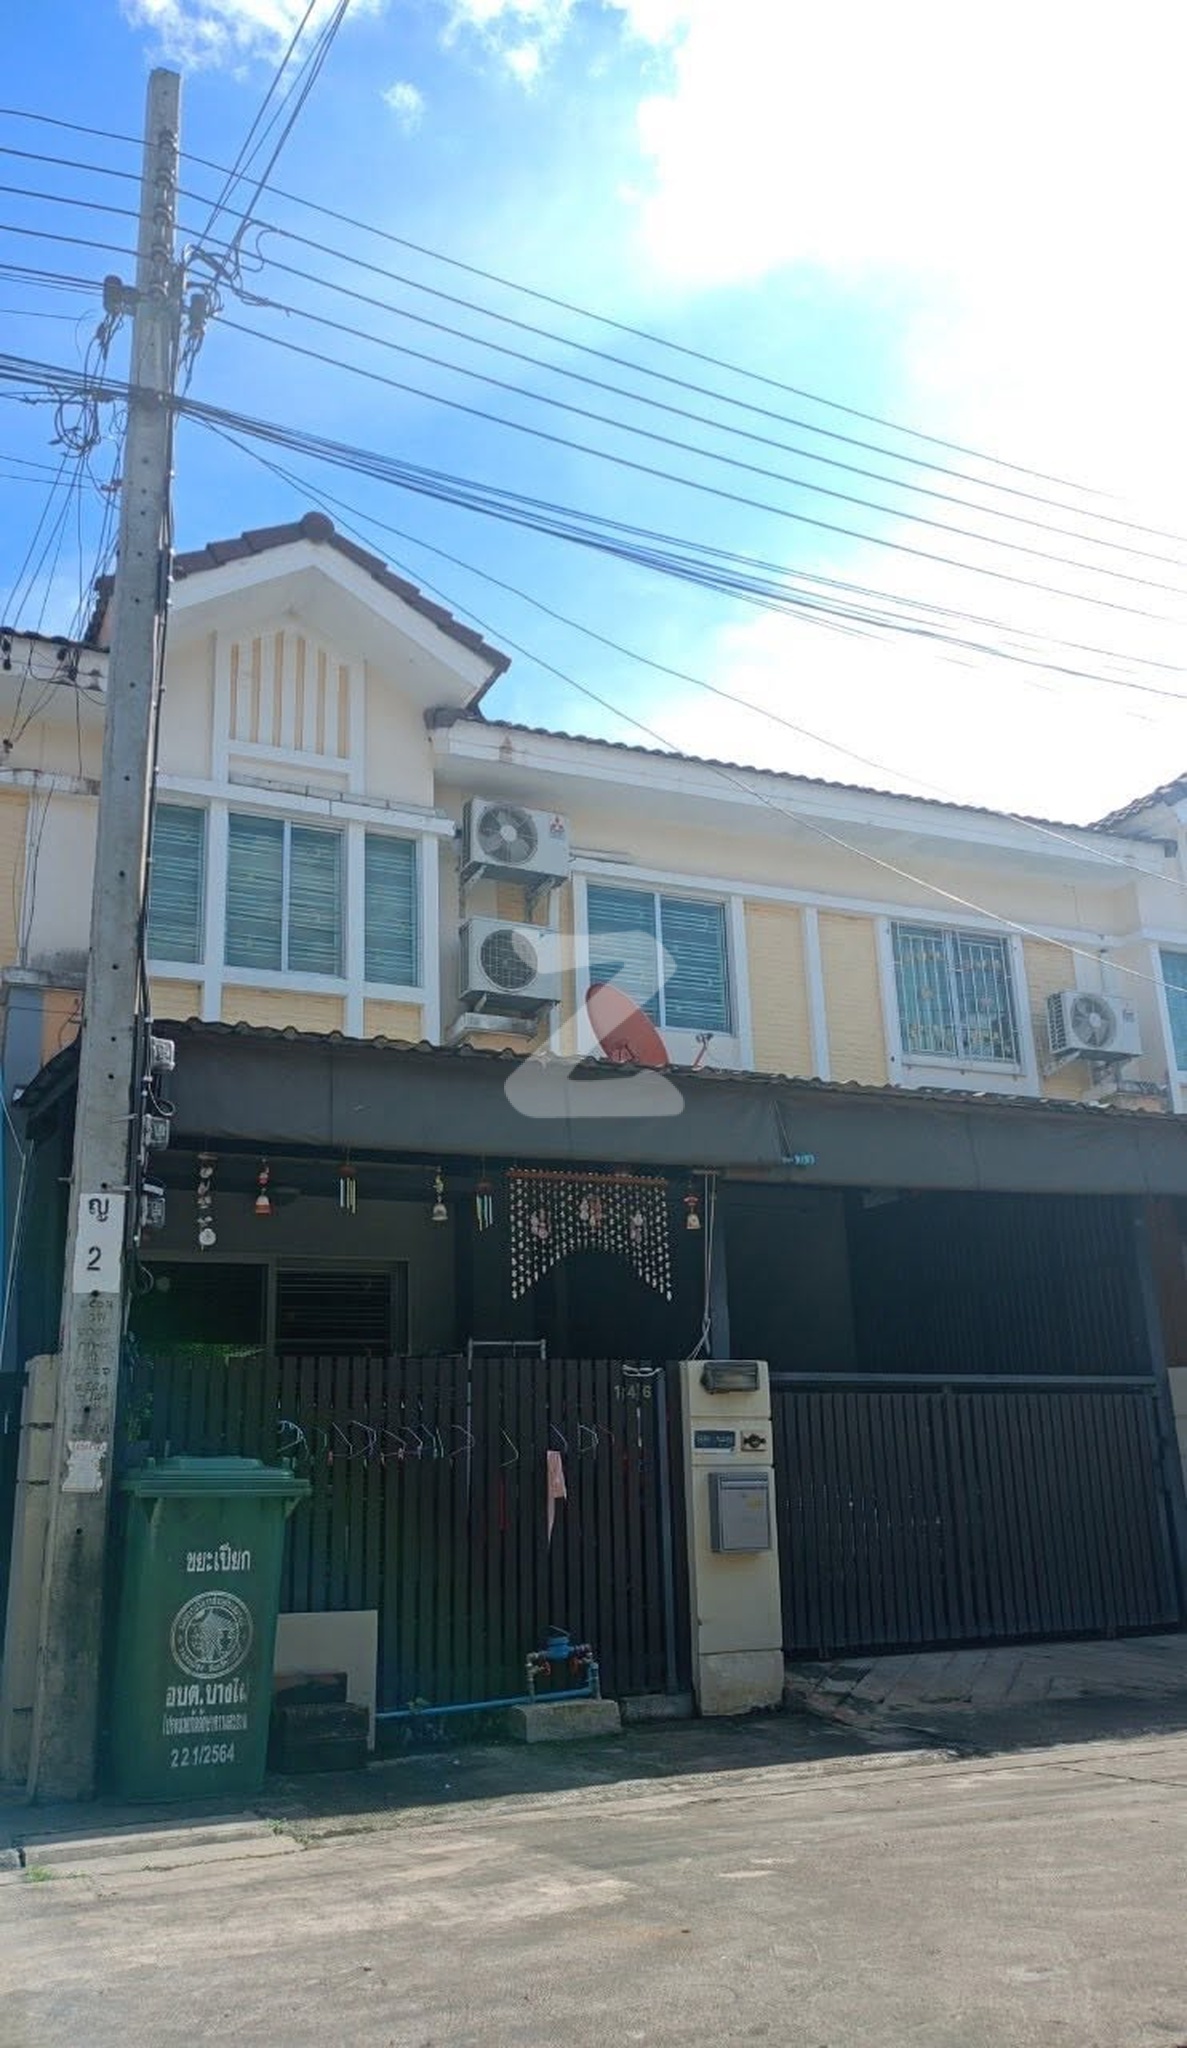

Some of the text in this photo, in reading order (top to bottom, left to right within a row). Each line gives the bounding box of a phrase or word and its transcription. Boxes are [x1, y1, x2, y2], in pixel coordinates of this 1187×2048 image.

[89, 1198, 109, 1222] ญ
[87, 1246, 101, 1271] 2
[186, 1542, 251, 1572] ขยะเปียก
